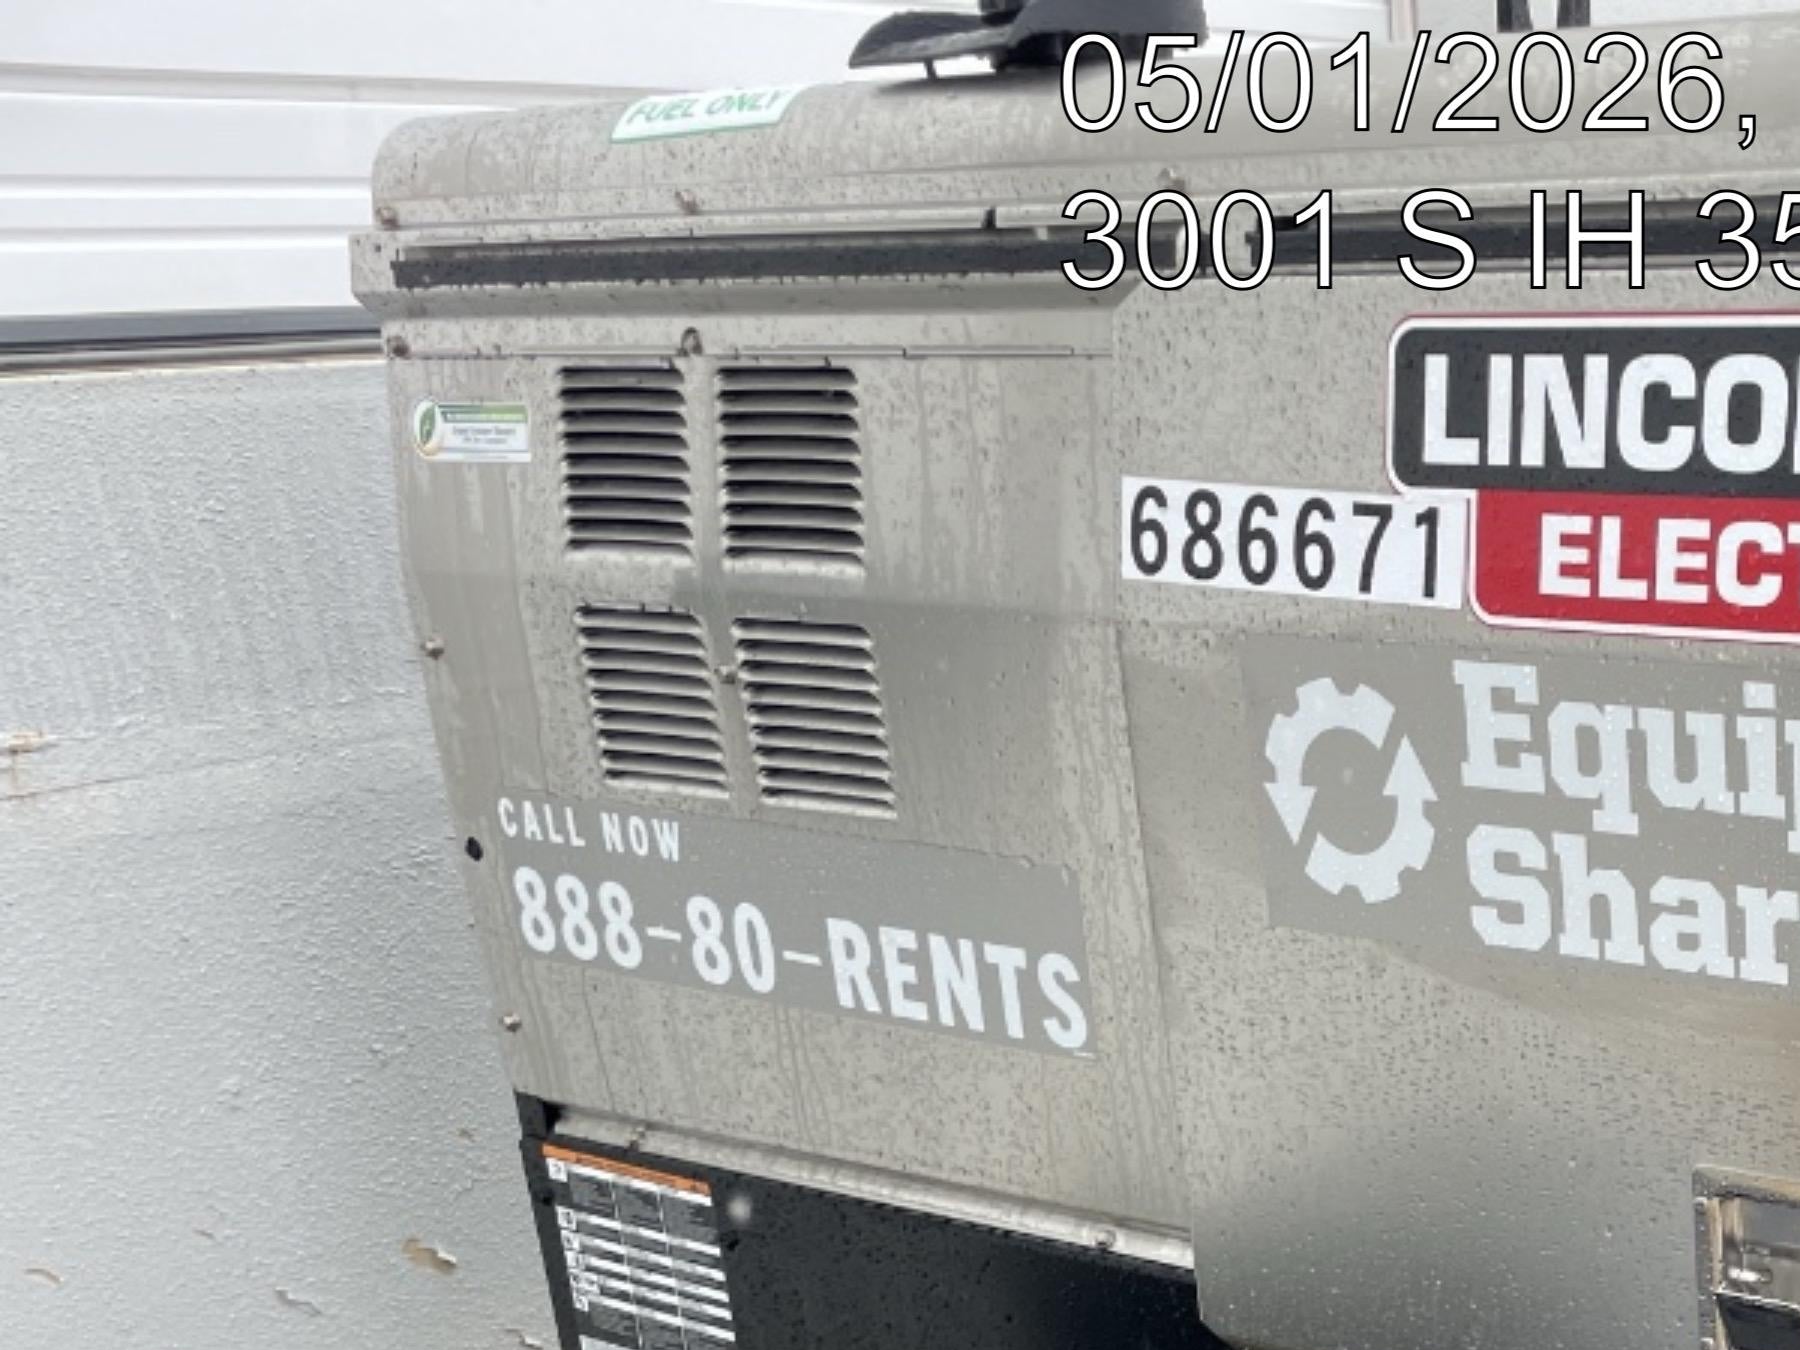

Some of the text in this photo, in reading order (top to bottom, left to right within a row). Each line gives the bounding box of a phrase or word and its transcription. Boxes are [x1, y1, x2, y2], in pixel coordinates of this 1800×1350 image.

[628, 90, 789, 123] FUEL ONLY
[1130, 485, 1442, 600] 686671
[498, 798, 682, 863] CALL NOW
[512, 865, 1089, 1050] 888-80-RENTS
